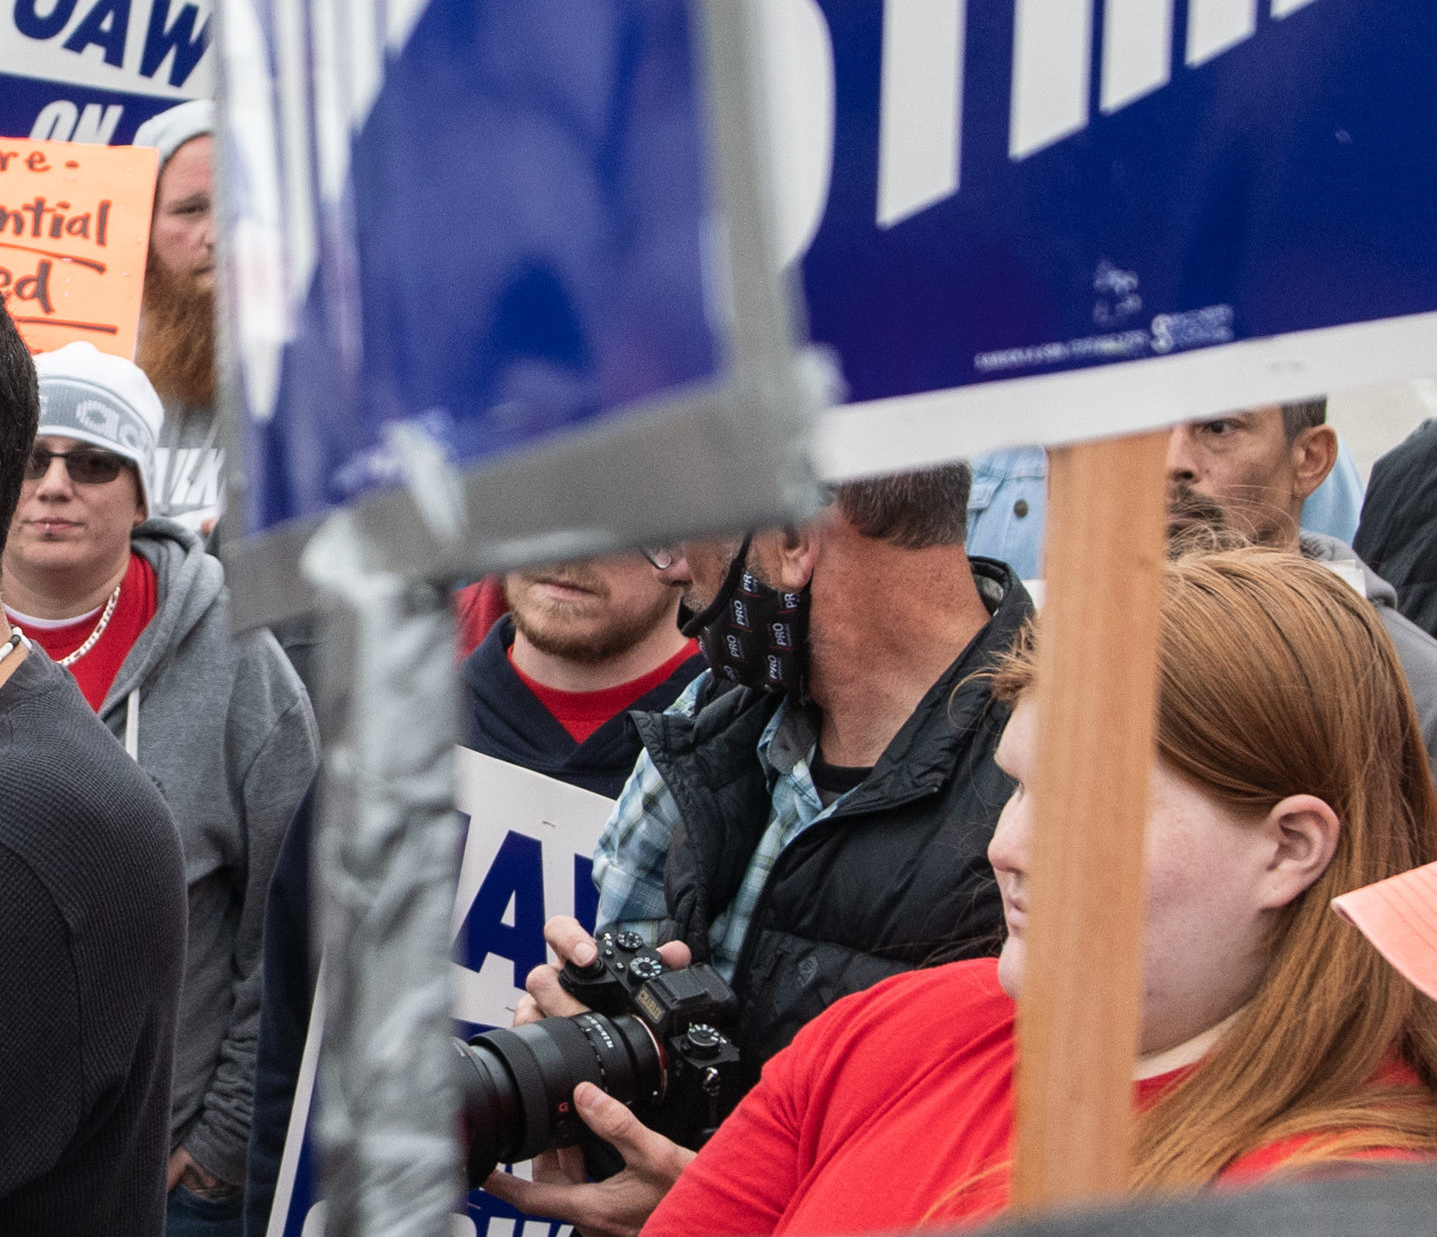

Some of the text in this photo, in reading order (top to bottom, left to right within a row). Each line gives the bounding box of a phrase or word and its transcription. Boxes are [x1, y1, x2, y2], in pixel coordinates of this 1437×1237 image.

[734, 600, 745, 626] PRO
[726, 635, 740, 658] PRO
[772, 623, 787, 646] PRO
[768, 655, 778, 680] PRO
